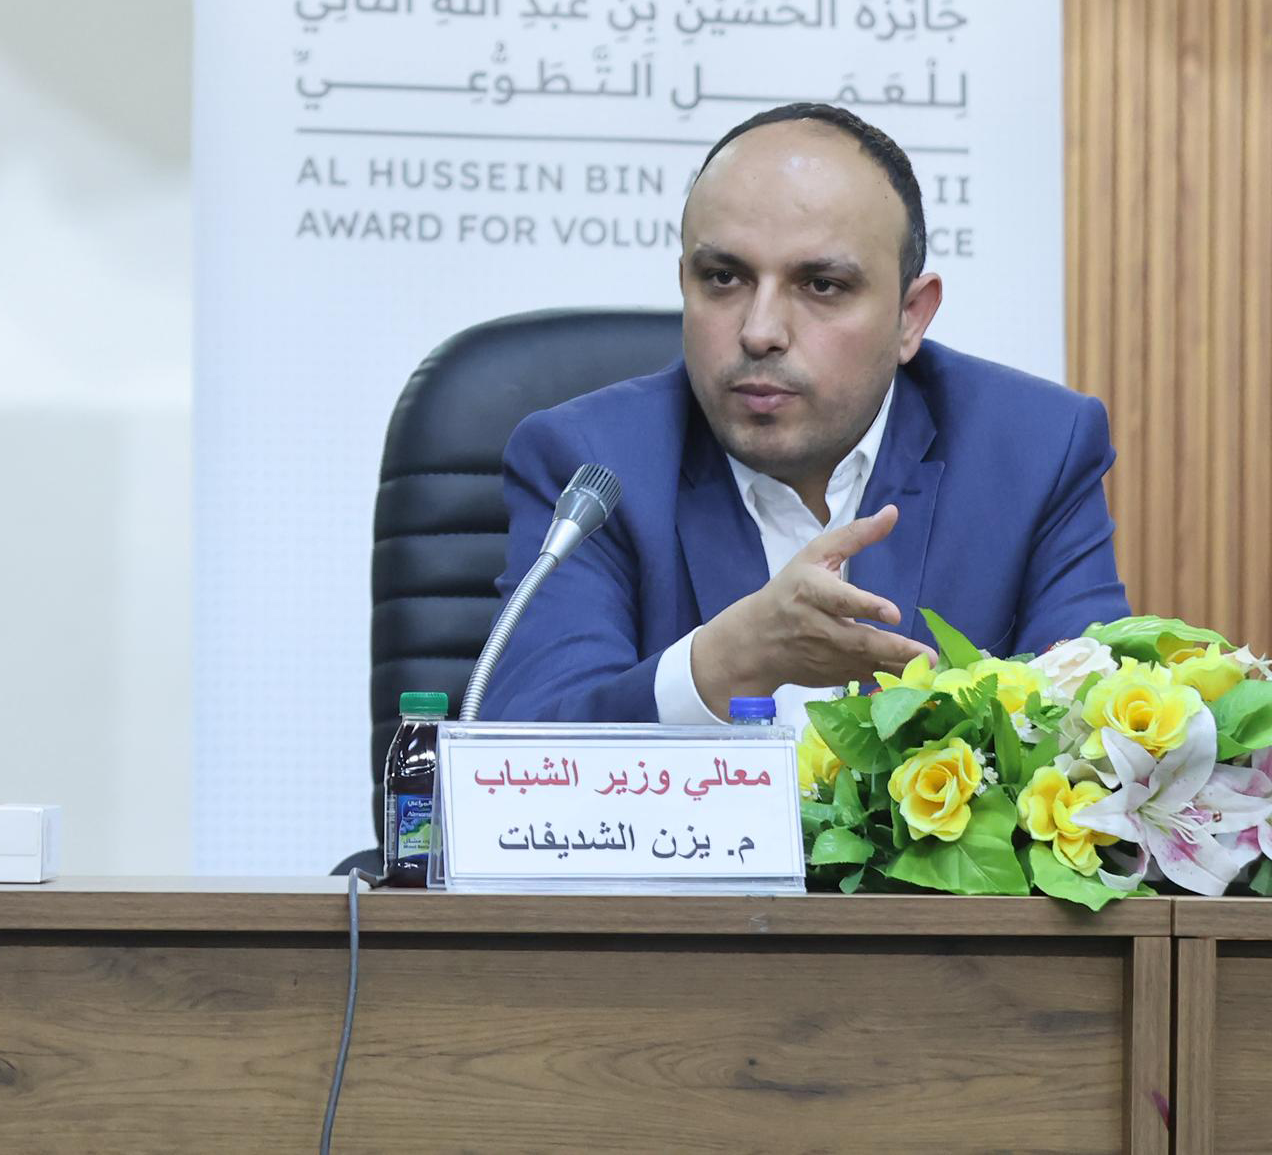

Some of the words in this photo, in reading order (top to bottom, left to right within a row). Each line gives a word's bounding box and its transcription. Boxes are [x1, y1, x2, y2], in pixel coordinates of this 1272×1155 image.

[296, 156, 348, 189] AL
[368, 158, 565, 194] HUSSEIN
[585, 163, 664, 196] BIN
[933, 174, 972, 204] II
[296, 209, 444, 244] AWARD
[458, 214, 537, 245] FOR
[552, 216, 683, 248] VOLUN
[474, 756, 580, 796] الشباب
[593, 760, 671, 796] وزير
[683, 756, 771, 802] معالي
[498, 821, 635, 860] الشديفات
[651, 824, 711, 860] يزن
